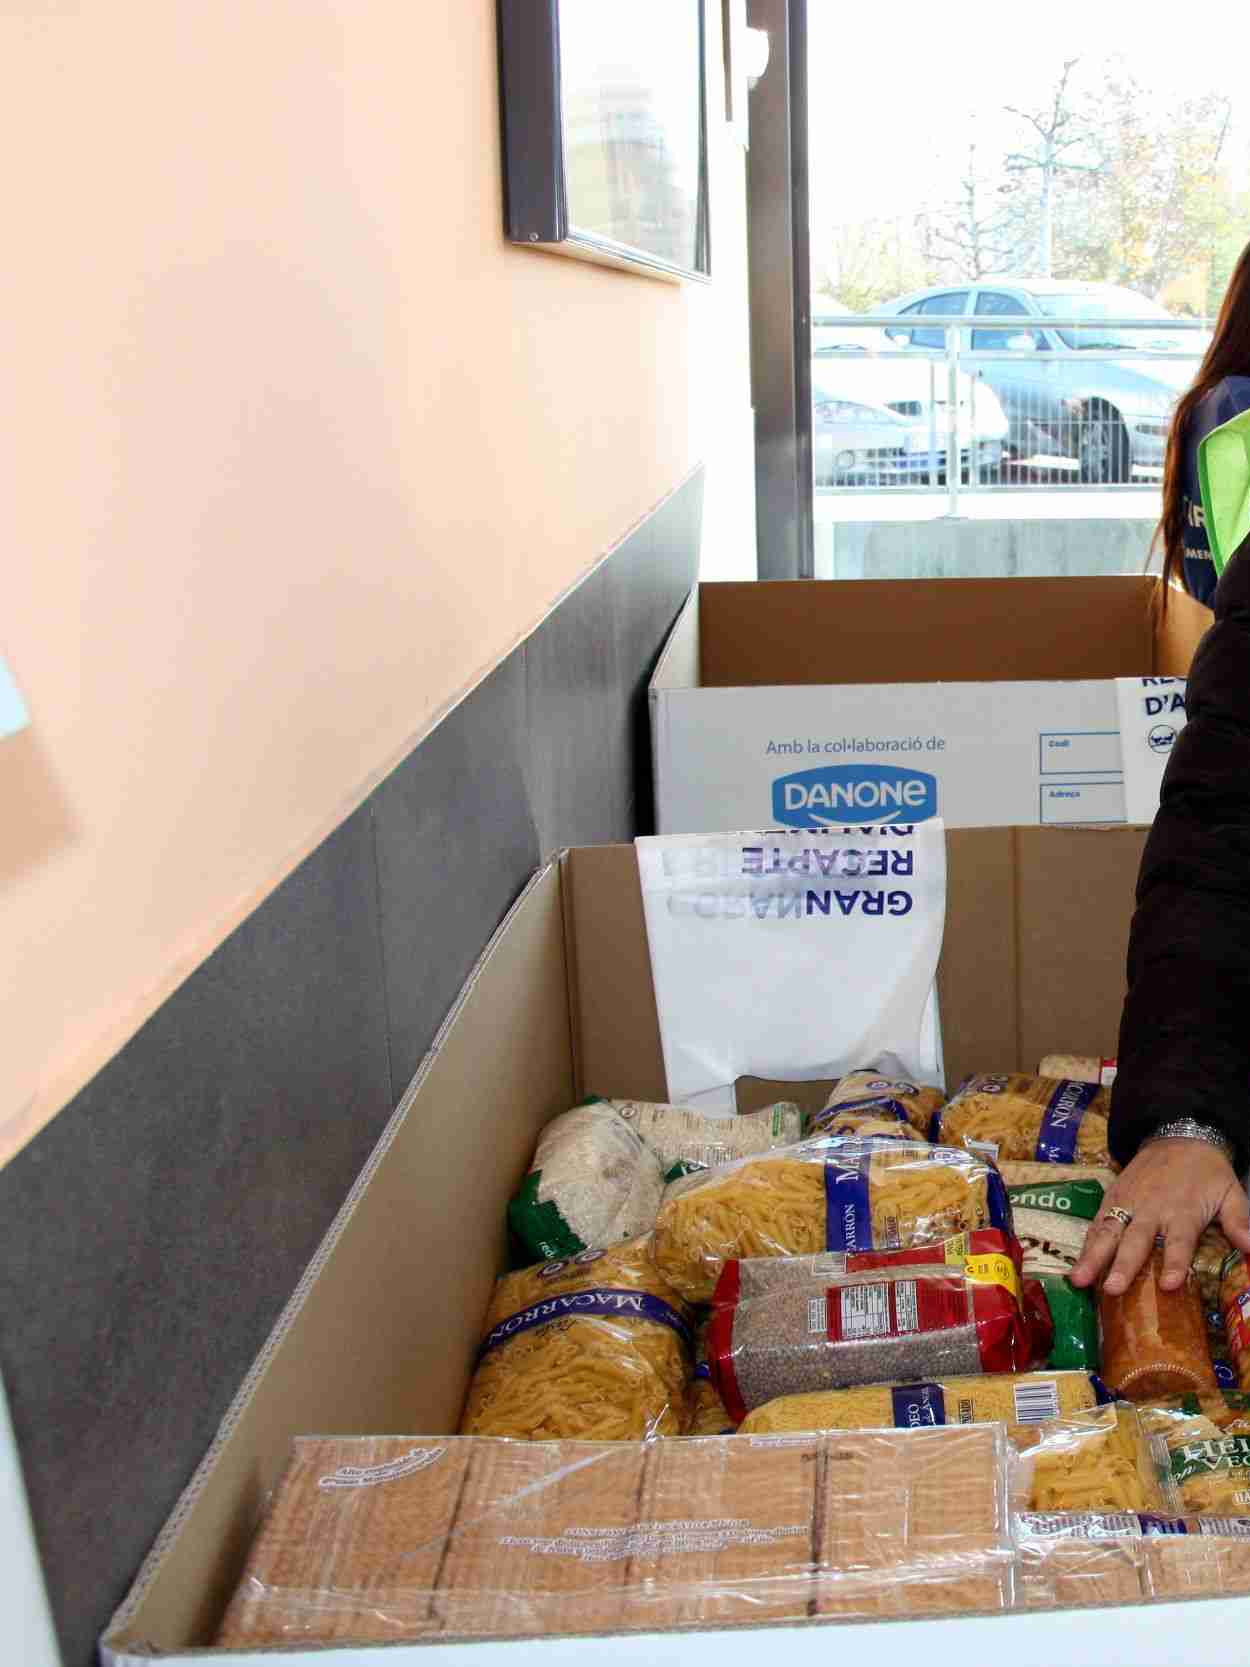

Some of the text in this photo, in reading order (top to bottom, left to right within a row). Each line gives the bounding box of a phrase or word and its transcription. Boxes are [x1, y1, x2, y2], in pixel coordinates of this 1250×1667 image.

[1145, 693, 1186, 716] D'A
[766, 738, 803, 755] Amb
[806, 738, 819, 754] la
[925, 735, 945, 752] de
[742, 847, 913, 876] RECAPTE
[806, 889, 913, 916] GRAN
